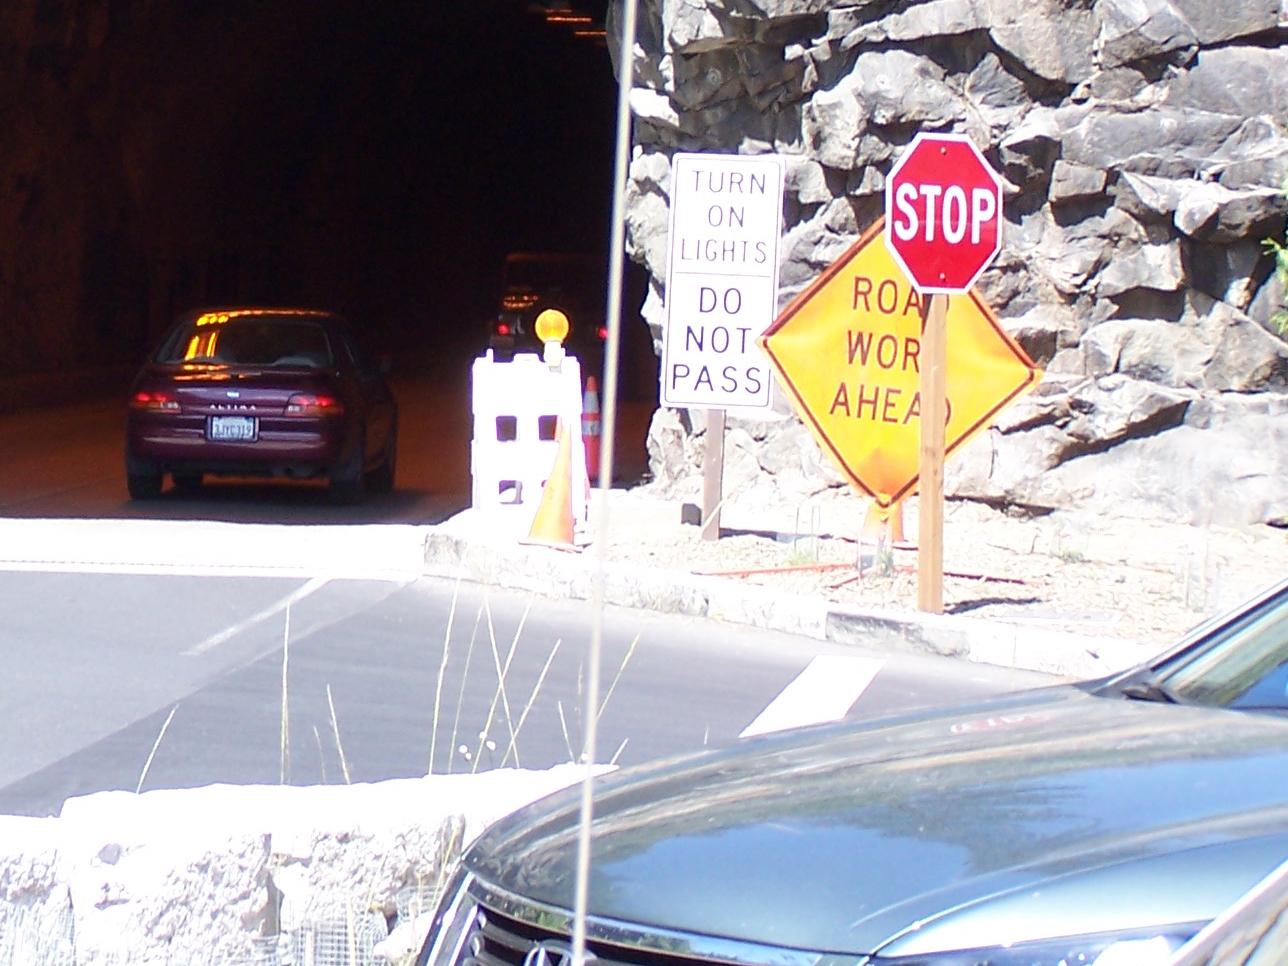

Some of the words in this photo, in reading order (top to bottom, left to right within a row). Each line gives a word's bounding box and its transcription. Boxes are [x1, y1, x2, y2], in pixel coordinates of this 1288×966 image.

[693, 171, 766, 195] TURN
[708, 205, 745, 228] ON
[894, 182, 995, 244] STOP
[681, 239, 767, 264] LIGHTS
[699, 287, 742, 315] DO
[852, 276, 950, 316] ROA
[686, 326, 752, 354] NOT
[847, 330, 921, 373] WOR
[672, 364, 762, 395] PASS
